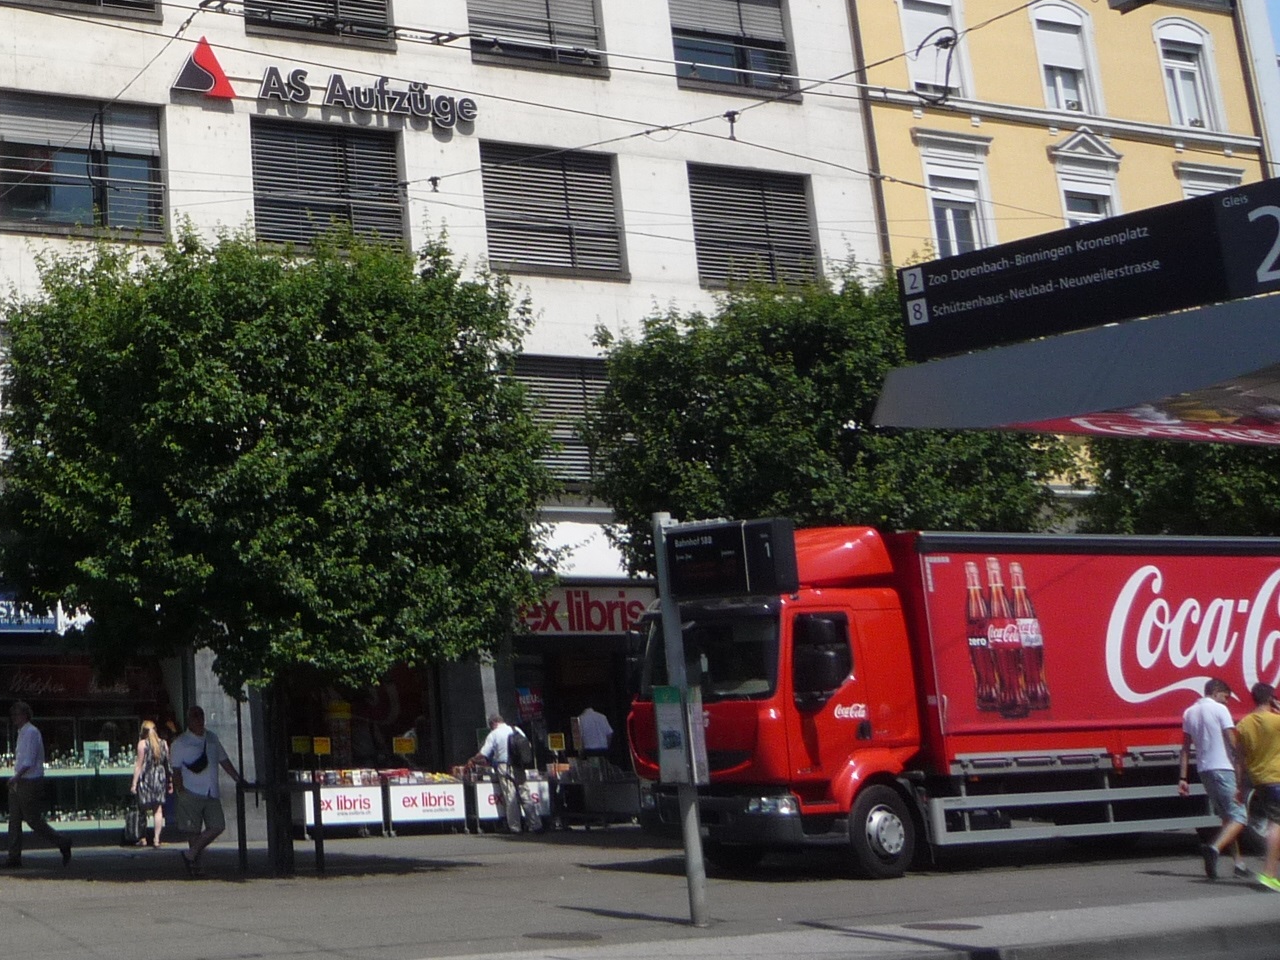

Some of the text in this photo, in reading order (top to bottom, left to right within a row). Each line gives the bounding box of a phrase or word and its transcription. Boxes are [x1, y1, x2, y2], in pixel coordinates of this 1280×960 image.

[259, 66, 478, 129] AS Aufzüge
[1222, 194, 1249, 208] Gleis
[1246, 204, 1280, 283] 2
[908, 272, 920, 291] 2
[928, 272, 949, 287] Zoo
[1075, 226, 1150, 253] Kronenplatz
[912, 303, 924, 322] 8
[764, 541, 771, 558] 1
[517, 590, 646, 632] ex libris
[320, 794, 371, 811] ex libris
[402, 791, 455, 808] ex libris
